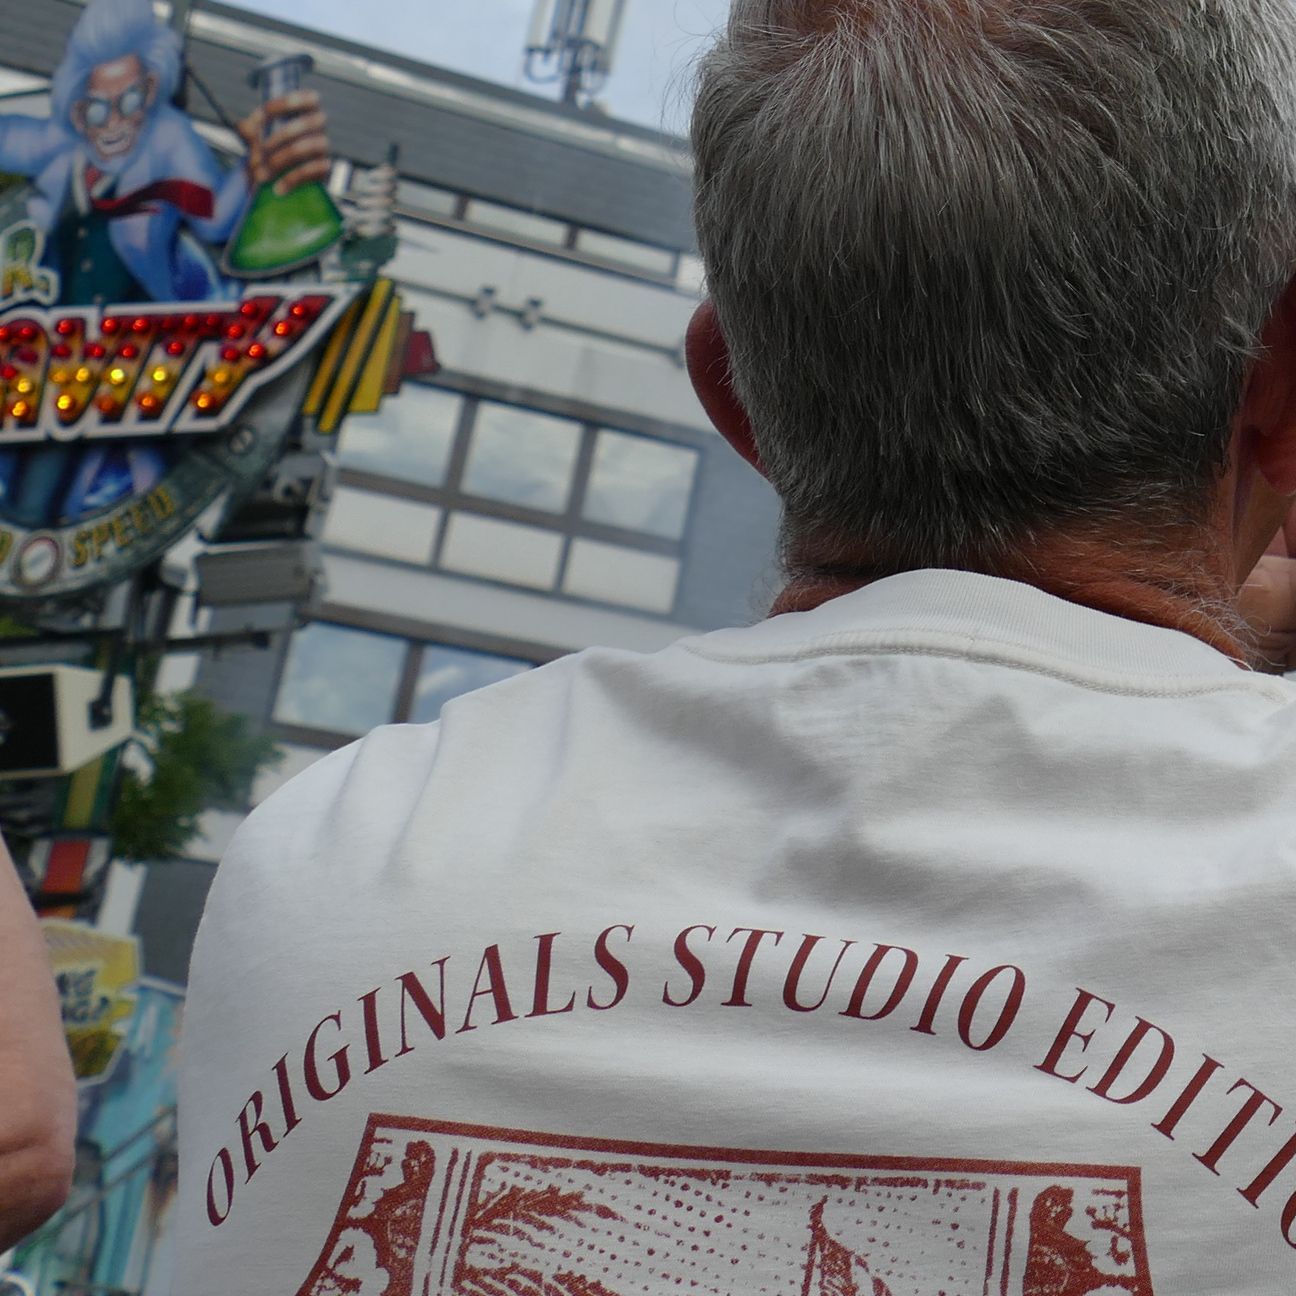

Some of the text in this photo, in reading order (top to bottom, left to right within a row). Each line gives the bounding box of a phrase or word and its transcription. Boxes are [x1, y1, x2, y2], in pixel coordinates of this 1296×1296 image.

[71, 486, 175, 568] SPEED
[206, 924, 636, 1227] ORIGINALS
[662, 924, 1026, 1051] STUDIO
